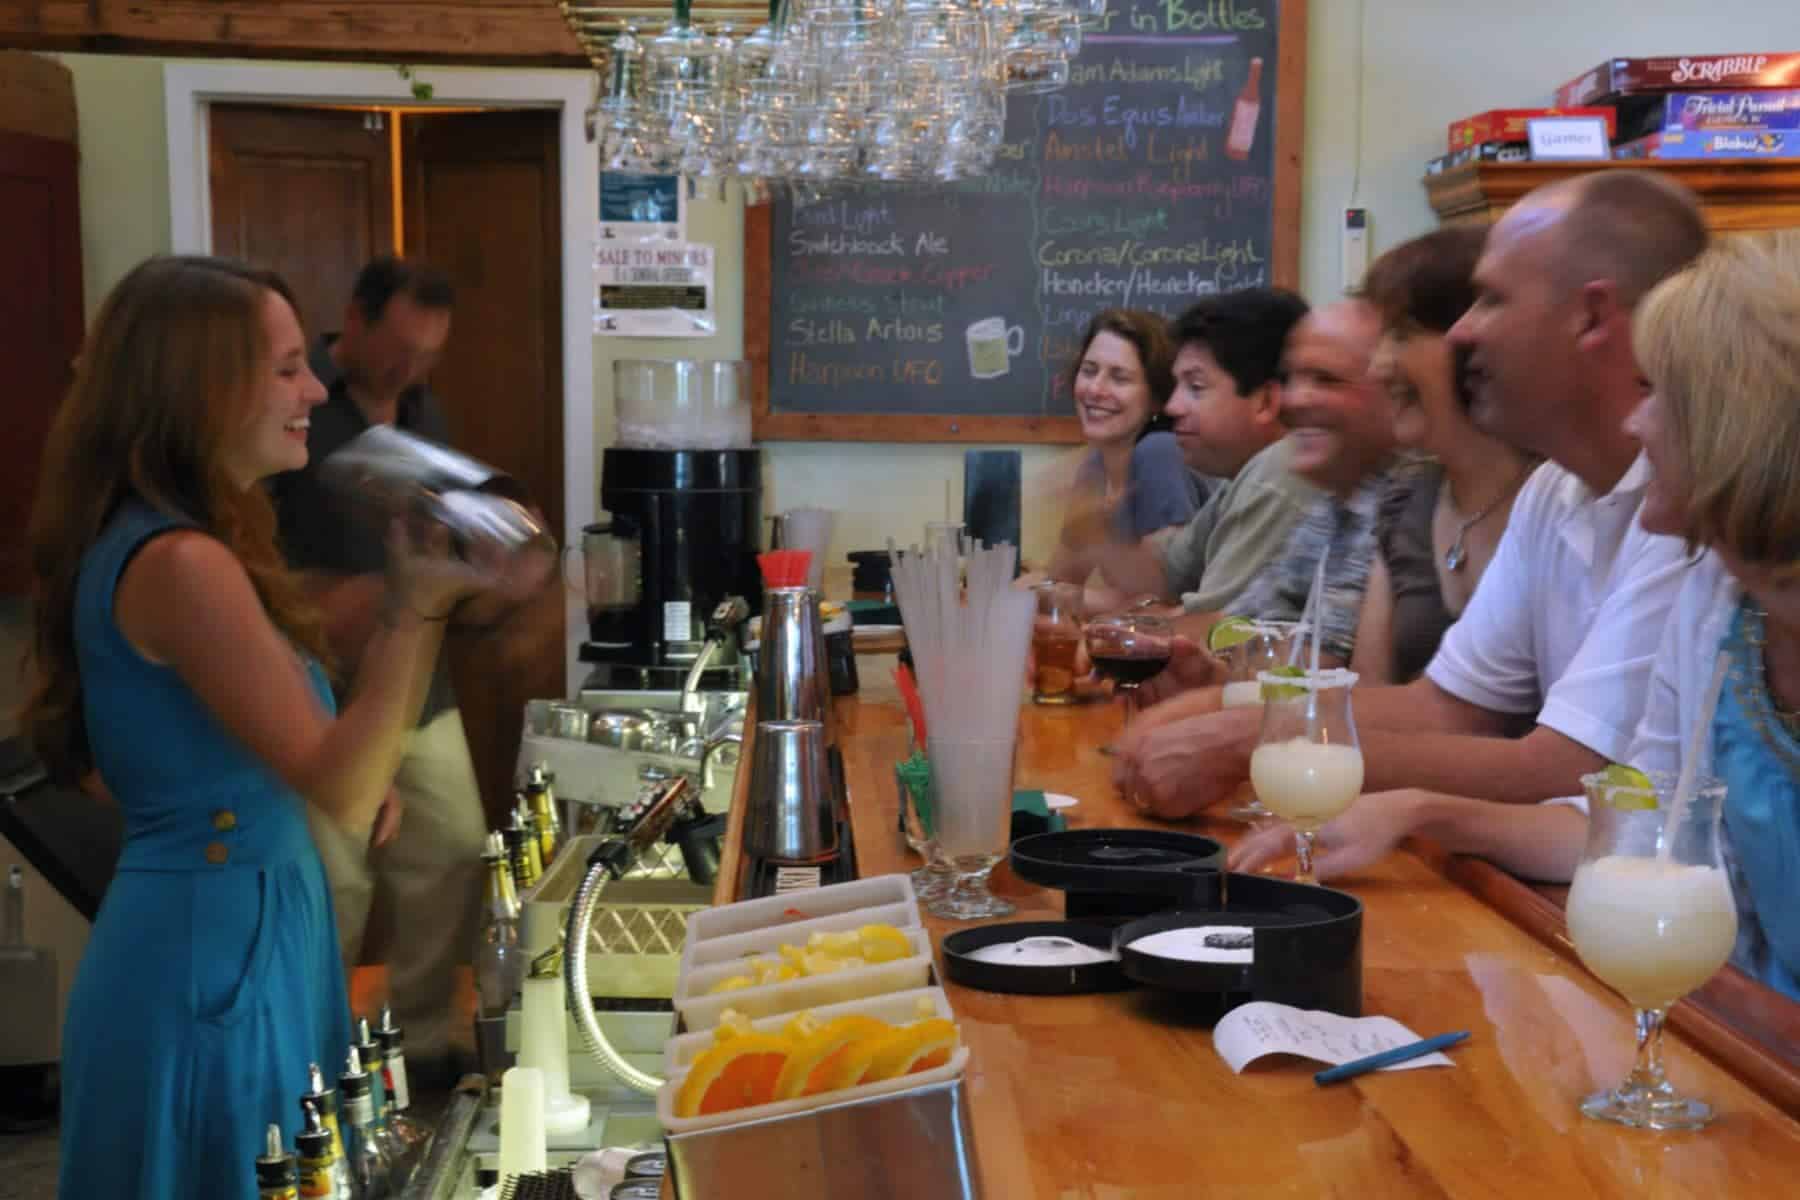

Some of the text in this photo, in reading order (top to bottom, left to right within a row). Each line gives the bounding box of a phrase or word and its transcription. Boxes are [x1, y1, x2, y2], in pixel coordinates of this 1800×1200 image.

[1131, 4, 1157, 32] in
[1166, 0, 1265, 31] Bottles
[1070, 62, 1104, 83] am
[1671, 55, 1767, 83] SCRABBLE
[1103, 95, 1171, 148] Equis
[657, 248, 708, 265] MINRS
